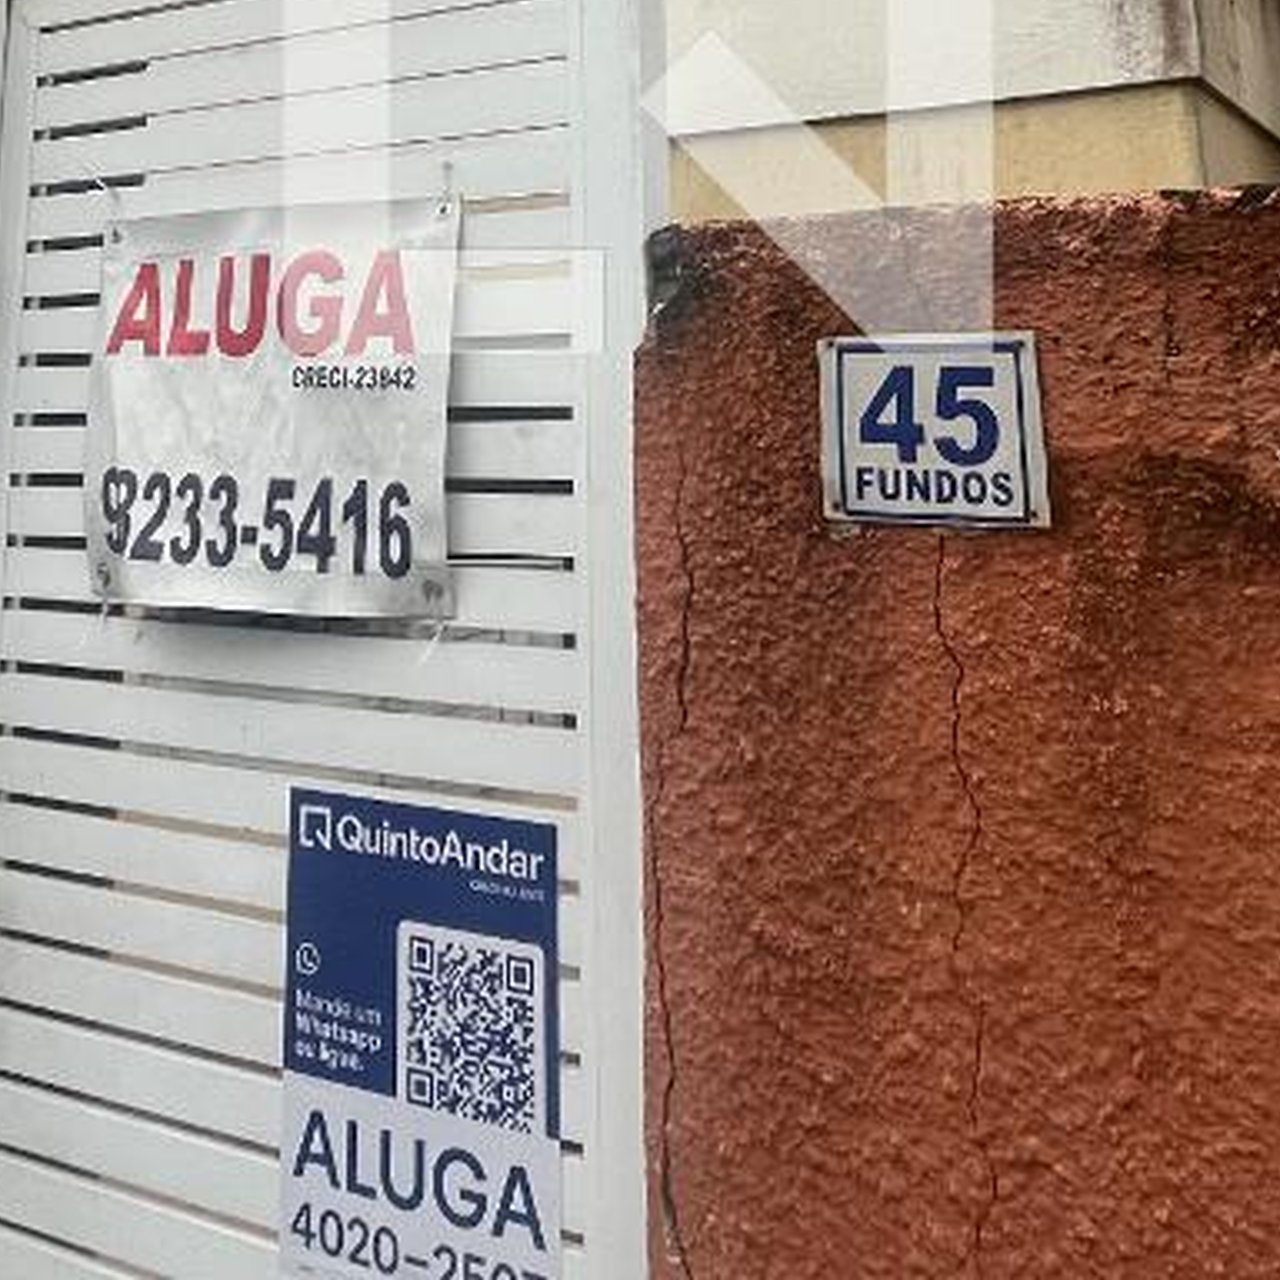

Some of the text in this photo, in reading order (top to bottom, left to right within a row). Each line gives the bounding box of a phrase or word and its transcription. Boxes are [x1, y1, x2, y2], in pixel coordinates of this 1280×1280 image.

[106, 249, 417, 357] ALUGA
[859, 365, 1000, 467] 45
[856, 466, 1014, 507] FUNDOS
[336, 815, 545, 881] QuintoAndar
[293, 1109, 547, 1251] ALUGA
[291, 1202, 549, 1280] 4020-25
